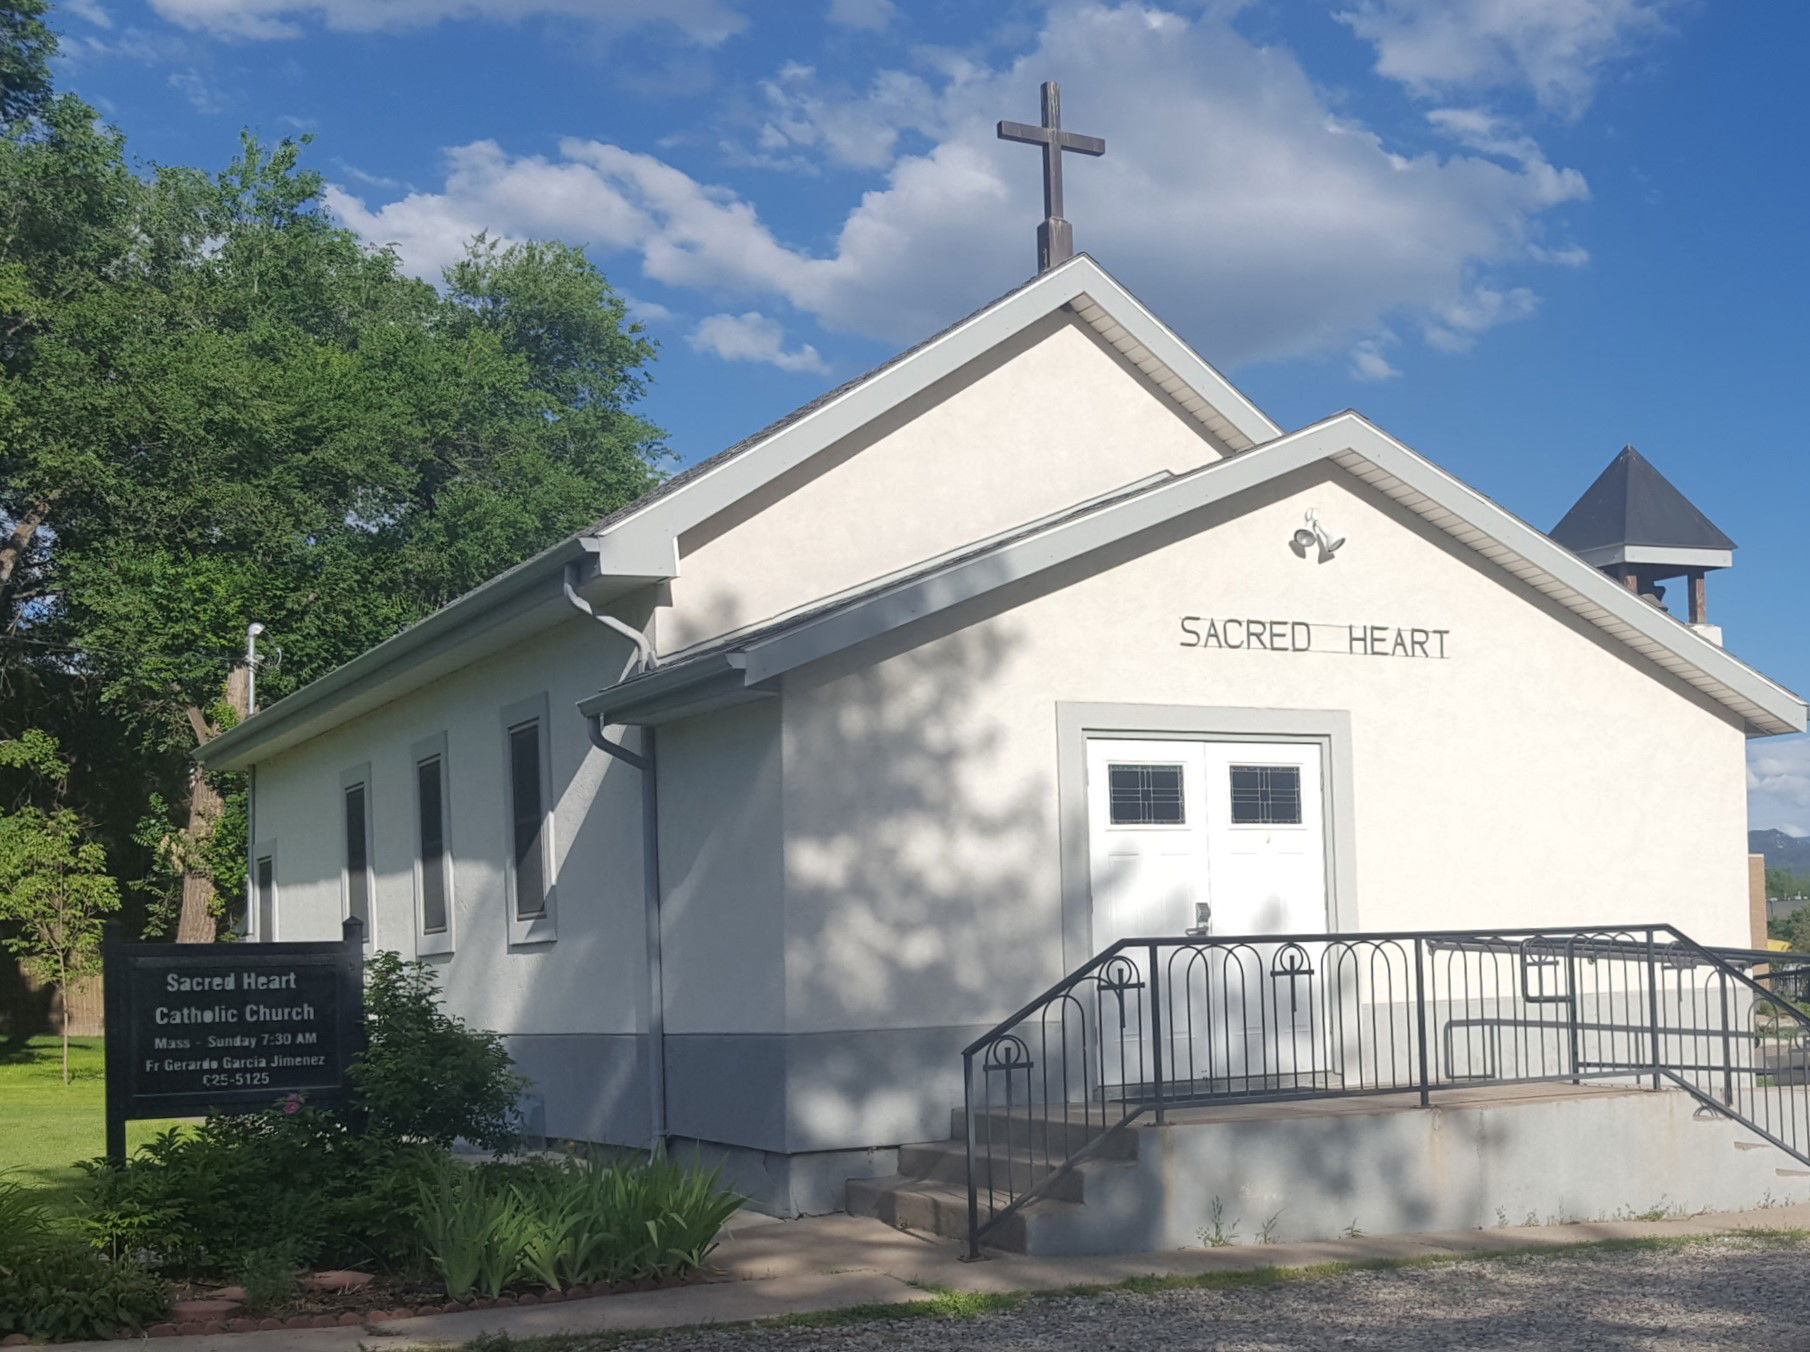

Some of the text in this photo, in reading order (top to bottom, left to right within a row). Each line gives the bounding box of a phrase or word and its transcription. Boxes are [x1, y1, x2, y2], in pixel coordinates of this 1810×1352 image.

[1180, 616, 1449, 658] SACRED HEART
[166, 972, 297, 991] Sacred Heart
[155, 1004, 315, 1025] Catholic Church
[154, 1038, 191, 1049] Mass
[207, 1036, 257, 1049] Sunday
[261, 1034, 292, 1046] 7:30
[296, 1033, 317, 1044] AM
[145, 1055, 326, 1072] Fr Gerardo Garcia Jimenez
